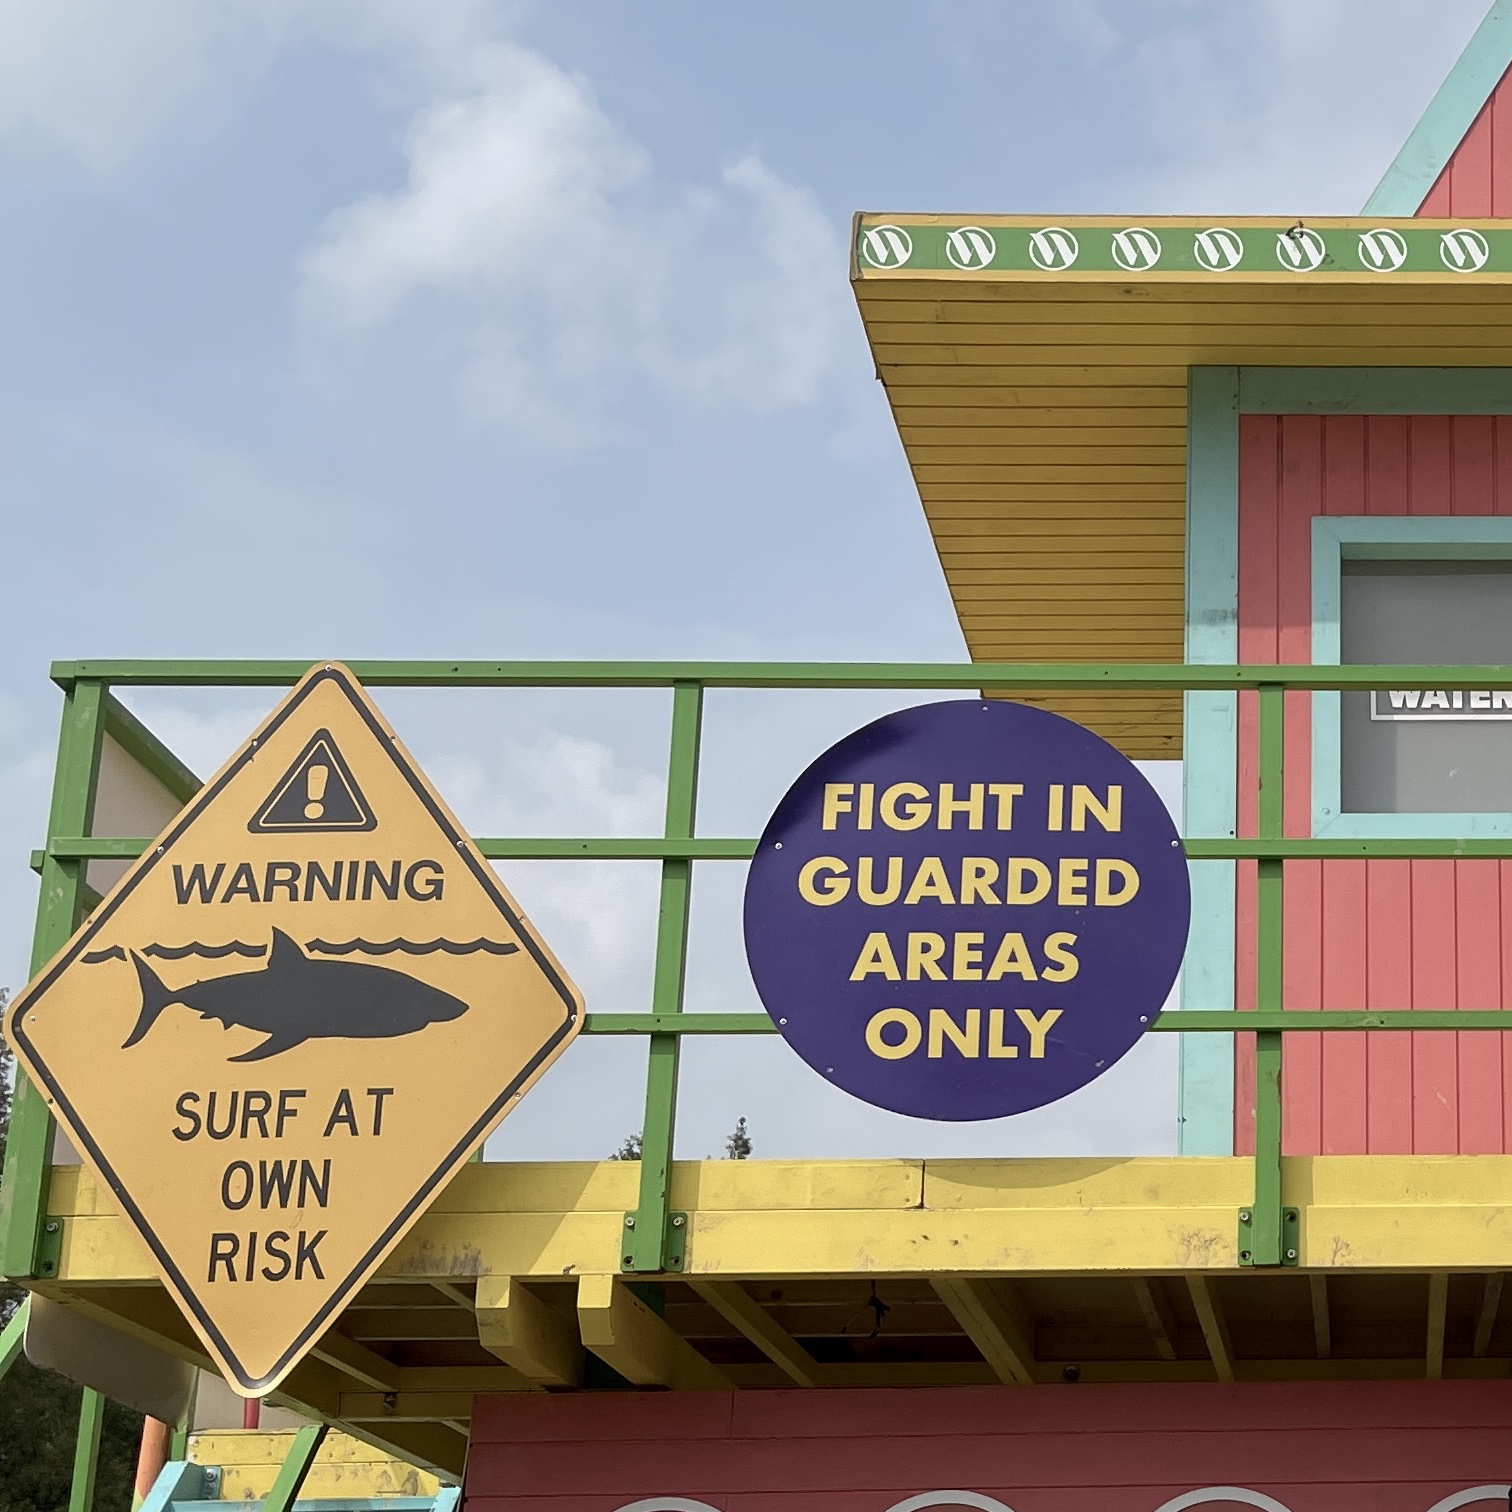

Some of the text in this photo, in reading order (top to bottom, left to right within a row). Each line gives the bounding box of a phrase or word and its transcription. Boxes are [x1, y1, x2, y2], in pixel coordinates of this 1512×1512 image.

[822, 782, 1122, 832] FIGHT IN
[172, 859, 446, 906] WARNING
[798, 856, 1140, 907] GUARDED
[849, 931, 1079, 983] AREAS
[865, 1008, 1064, 1060] ONLY
[171, 1087, 394, 1142] SURF AT
[221, 1158, 332, 1211] OWN
[207, 1230, 328, 1283] RISK
